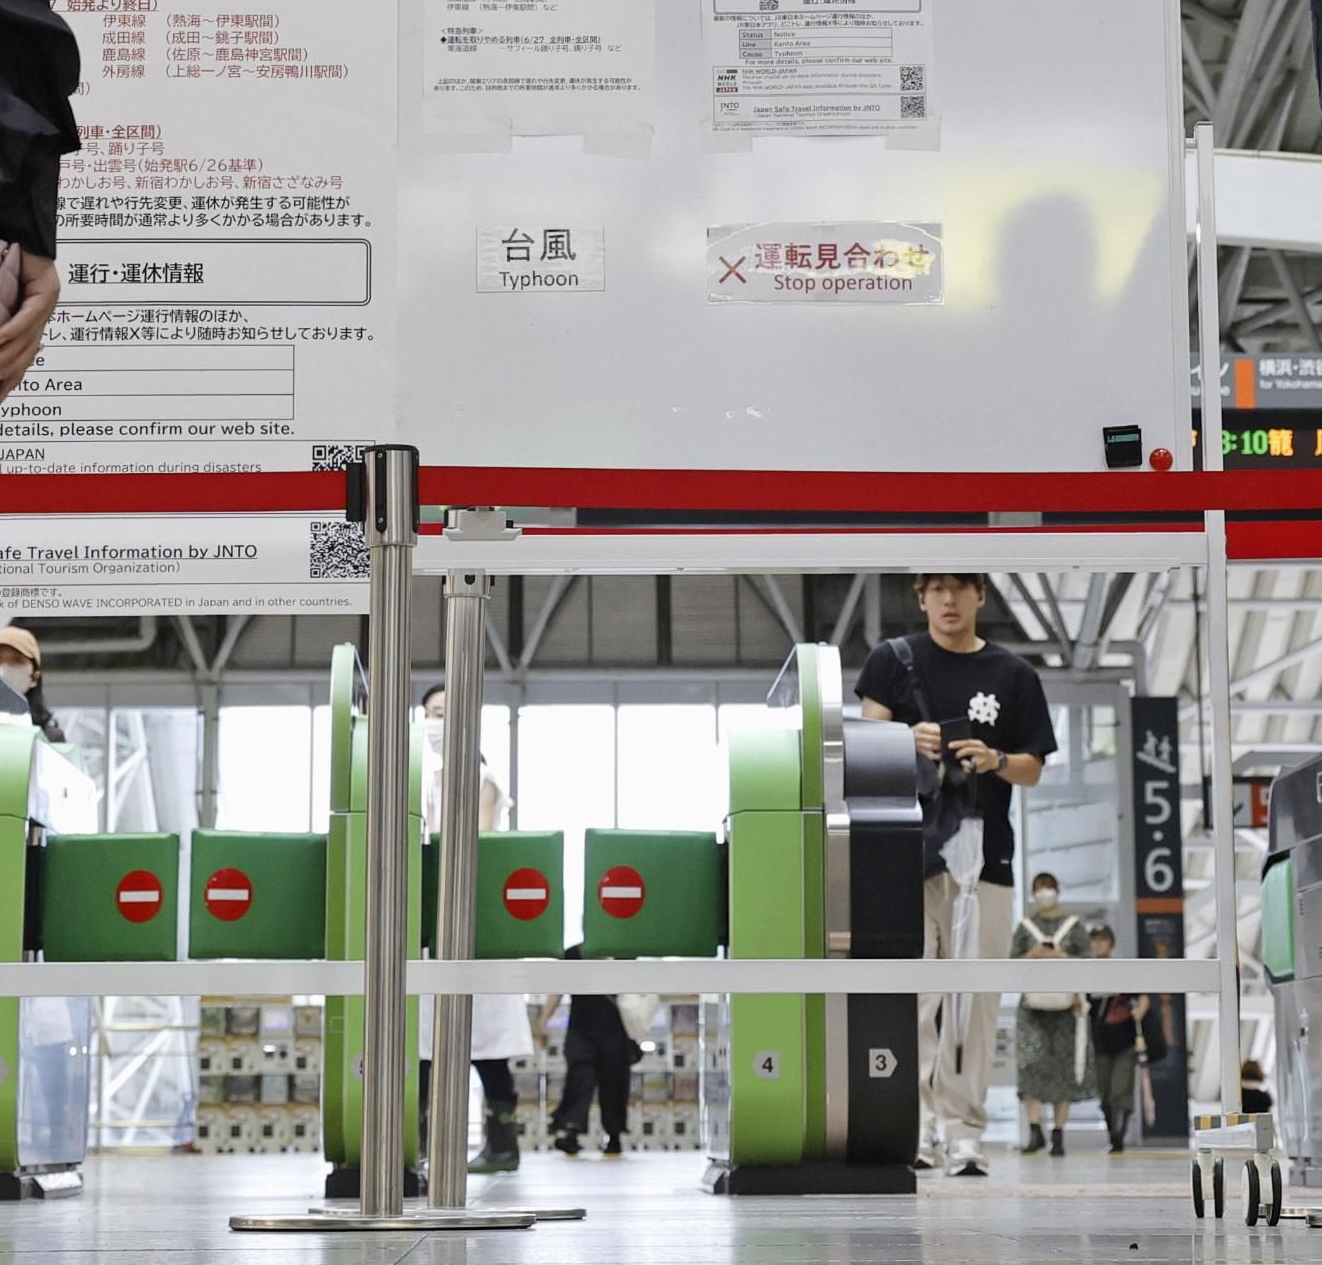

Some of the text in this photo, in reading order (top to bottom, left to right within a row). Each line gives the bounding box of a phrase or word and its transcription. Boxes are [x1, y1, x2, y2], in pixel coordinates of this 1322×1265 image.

[102, 14, 147, 28] 伊東線
[102, 30, 147, 45] 成田線
[102, 47, 147, 62] 鹿島線
[102, 64, 147, 79] 外房線
[501, 228, 577, 263] 台風
[754, 242, 931, 271] 運転見合わせ
[68, 262, 205, 285] 運行・運休情報
[499, 270, 579, 290] Typhoon
[773, 274, 914, 293] Stop operation
[45, 377, 83, 391] Area
[60, 421, 115, 438] please
[118, 421, 183, 436] confirm
[188, 423, 216, 436] our
[221, 421, 255, 435] web
[260, 421, 296, 435] site.
[7, 462, 77, 475] up-to-date
[80, 461, 155, 474] information
[158, 461, 200, 473] during
[203, 460, 263, 473] disasters
[27, 545, 79, 560] Travel
[84, 544, 183, 560] Information
[188, 544, 209, 561] by
[213, 543, 259, 559] JNTO
[38, 562, 90, 575] Tourism
[93, 561, 181, 575] Organization)
[7, 599, 20, 610] of
[22, 598, 60, 609] DENSO
[62, 598, 93, 609] WAVE
[95, 597, 183, 609] INCORPORATED
[185, 597, 195, 607] in
[197, 597, 229, 609] Japan
[232, 597, 252, 607] and
[255, 596, 265, 607] in
[267, 596, 297, 607] other
[299, 596, 353, 607] countries.
[761, 1057, 774, 1073] 4
[875, 1056, 888, 1073] 3
